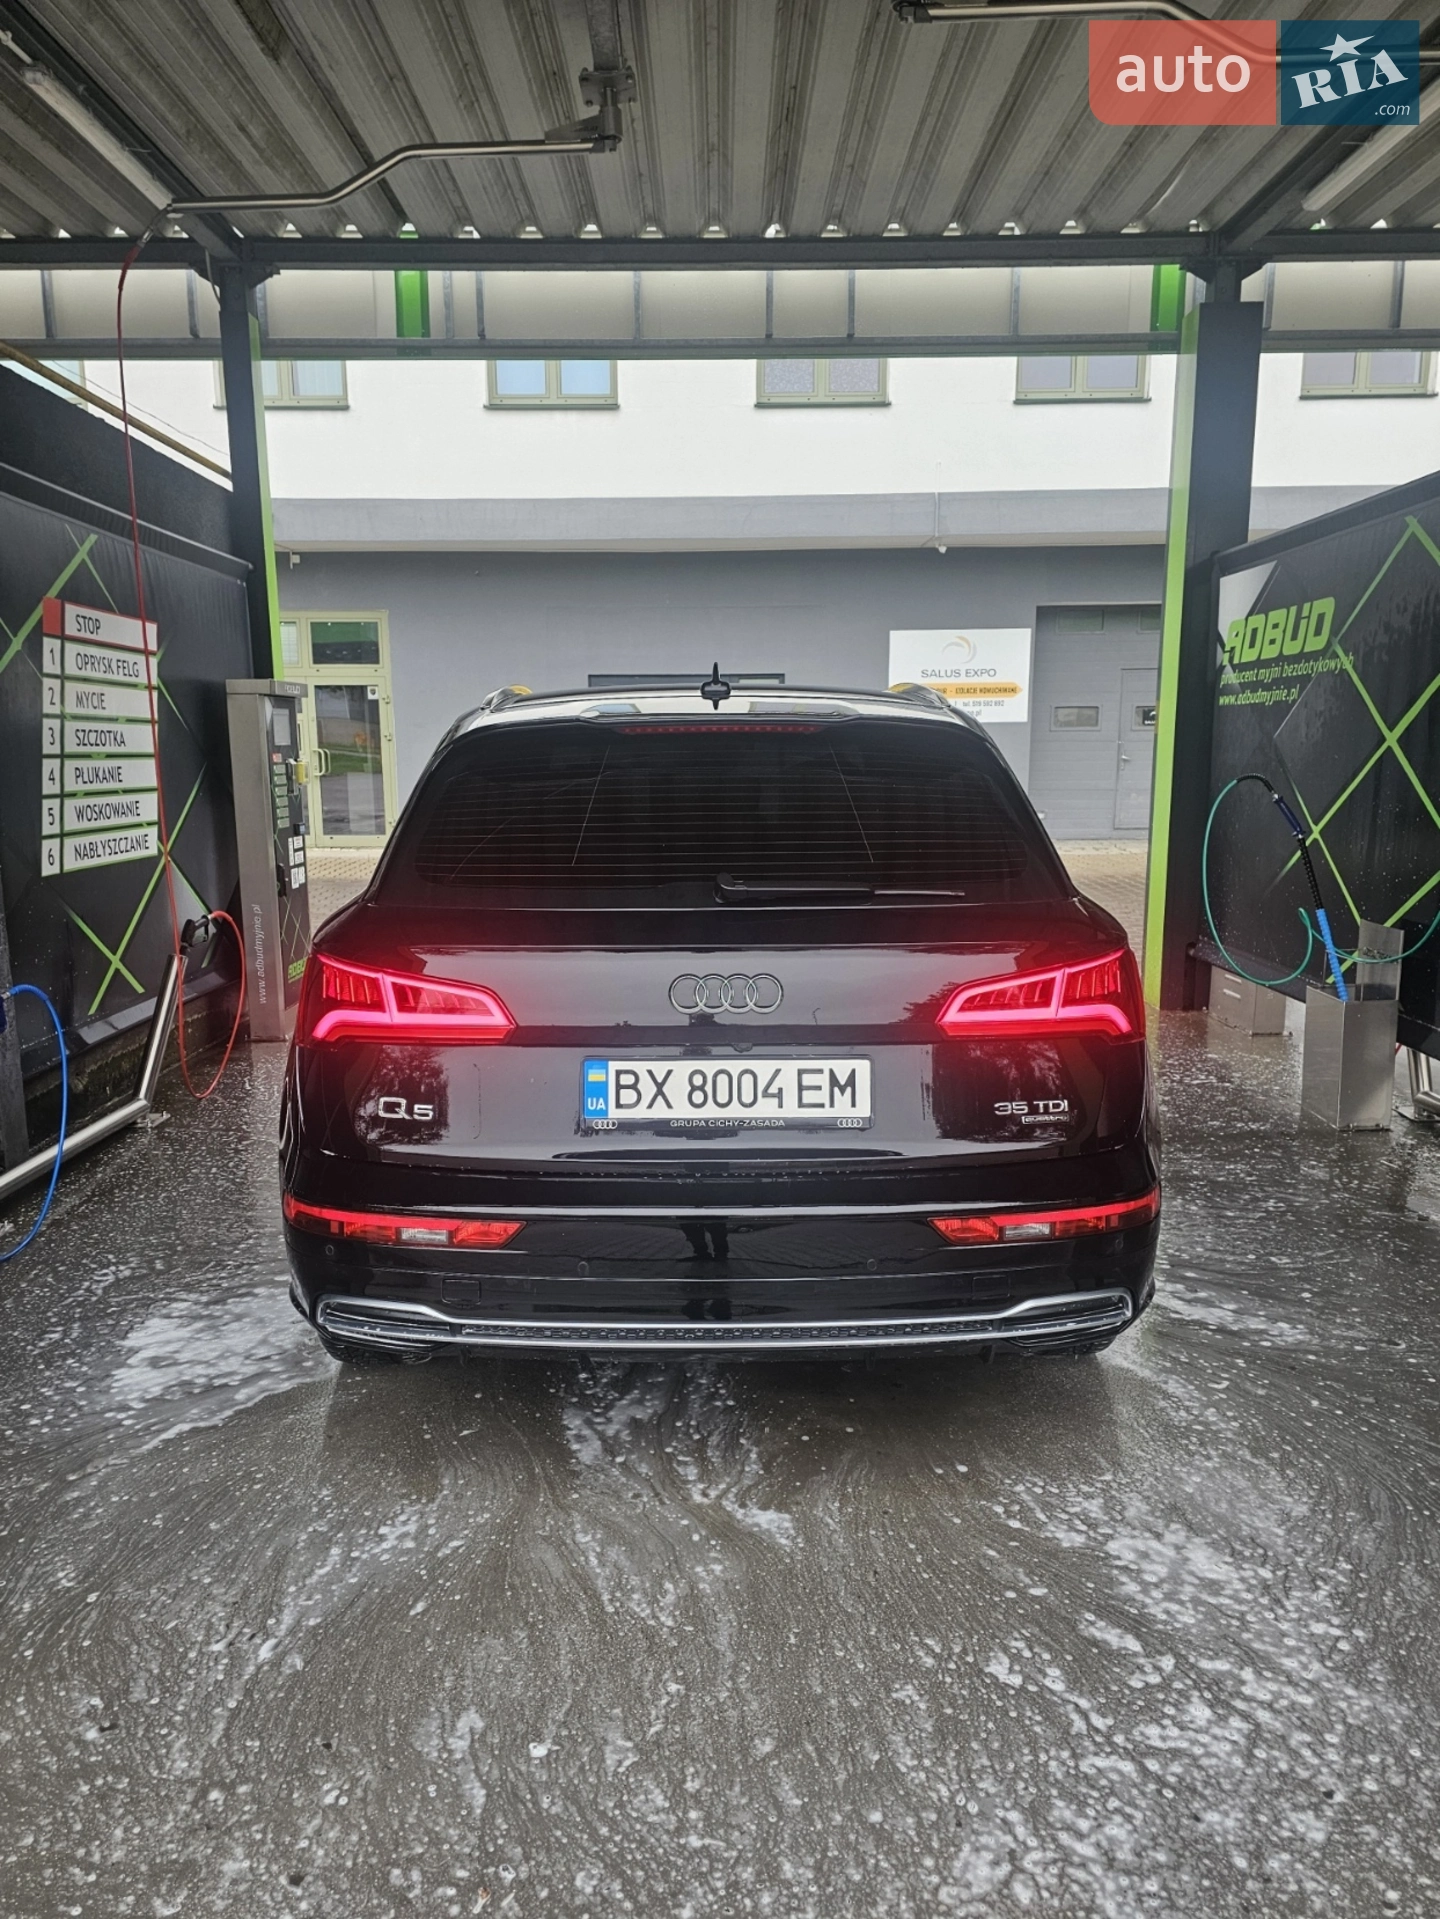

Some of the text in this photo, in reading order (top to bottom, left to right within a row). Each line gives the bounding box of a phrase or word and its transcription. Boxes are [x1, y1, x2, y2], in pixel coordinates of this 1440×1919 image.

[74, 613, 102, 636] STOP
[1222, 596, 1336, 667] ADBUD
[49, 646, 140, 678] 1 OPRYSK FELG
[920, 668, 998, 679] SALUS EXPO
[1219, 667, 1258, 688] producent
[1257, 661, 1282, 683] myjni
[48, 686, 107, 711] 2 MYCIE
[1218, 683, 1300, 706] www.adbudmyjnie.pl
[48, 726, 127, 748] 3 SZCZOTKA
[47, 765, 124, 786] 4 PŁUKANIE
[47, 800, 141, 826] 5 WOSKOWANIE
[47, 833, 150, 867] 6 NABŁYSZCZANIE
[251, 903, 267, 1005] www.adbudmyjnie.pl
[613, 1068, 857, 1110] BX 8004 EM
[378, 1096, 434, 1120] Q5
[587, 1098, 606, 1110] UA
[993, 1099, 1069, 1116] 35 TDI
[669, 1119, 785, 1127] GRUPA CICHY-ZASADA
